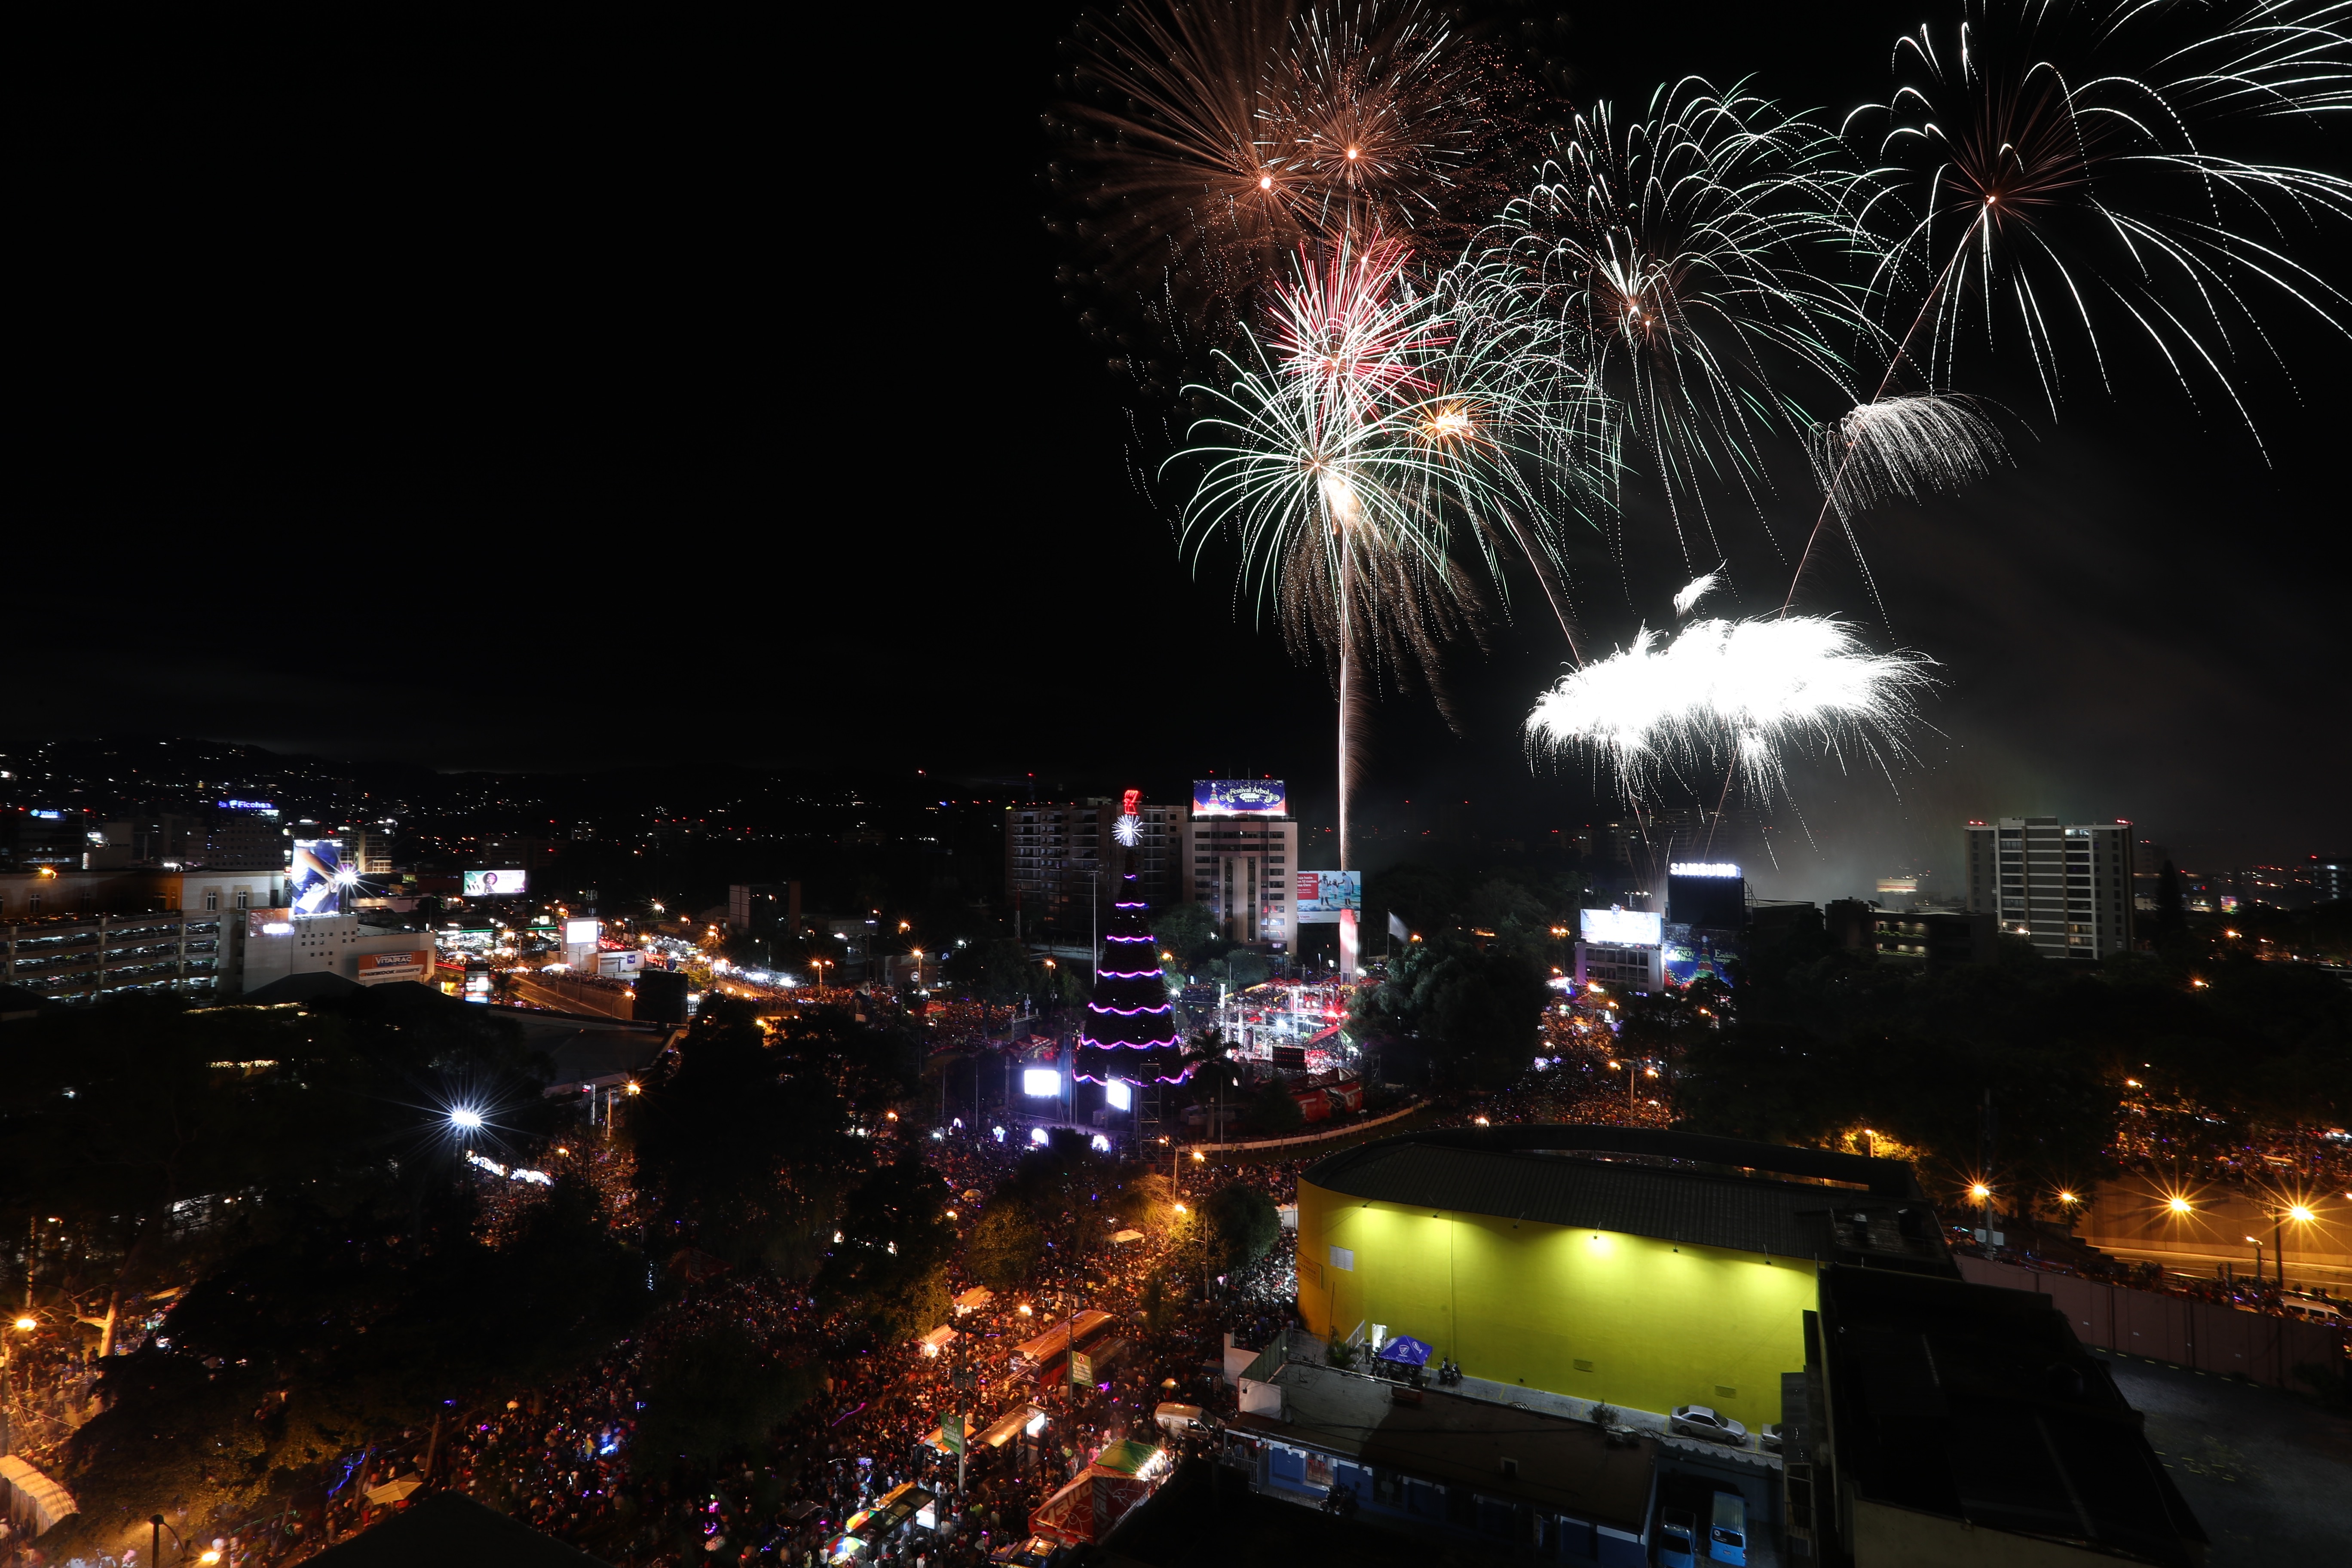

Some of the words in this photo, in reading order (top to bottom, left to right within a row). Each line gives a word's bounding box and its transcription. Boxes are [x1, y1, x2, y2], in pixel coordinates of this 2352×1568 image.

[1253, 785, 1269, 795] Árbol
[1670, 863, 1741, 877] SAMSUNG
[1669, 949, 1681, 961] 16
[1038, 1479, 1092, 1524] Gallo
